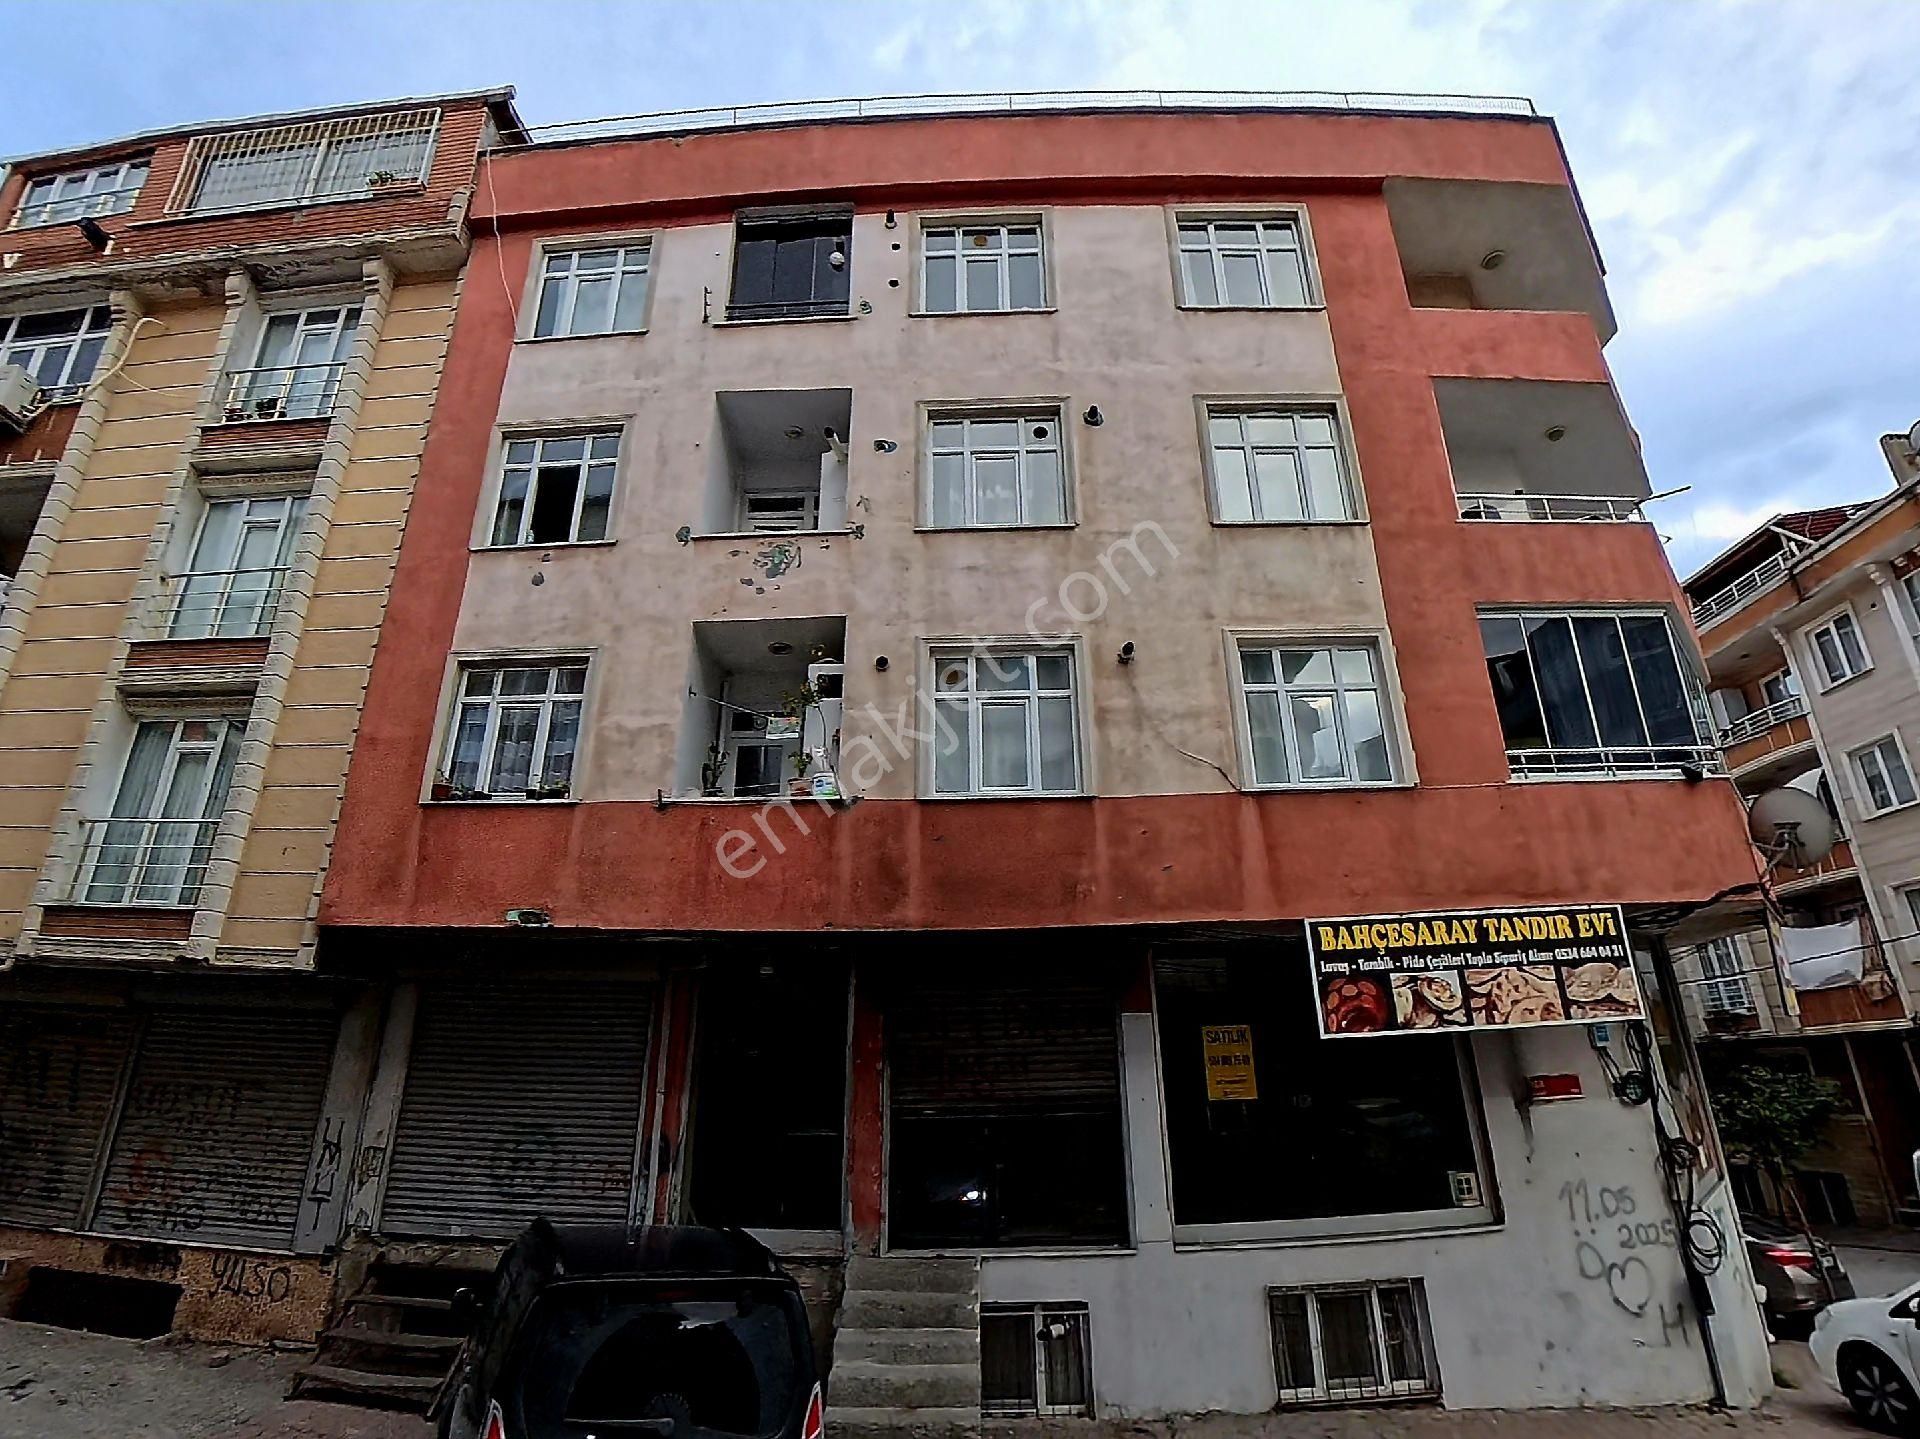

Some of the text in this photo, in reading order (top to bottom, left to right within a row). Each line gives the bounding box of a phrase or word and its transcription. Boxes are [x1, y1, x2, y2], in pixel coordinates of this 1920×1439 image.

[1318, 919, 1478, 955] BAHÇESARAY
[1483, 914, 1574, 942] TANDIR
[1402, 955, 1425, 969] Pide
[1559, 1178, 1636, 1223] 11.05
